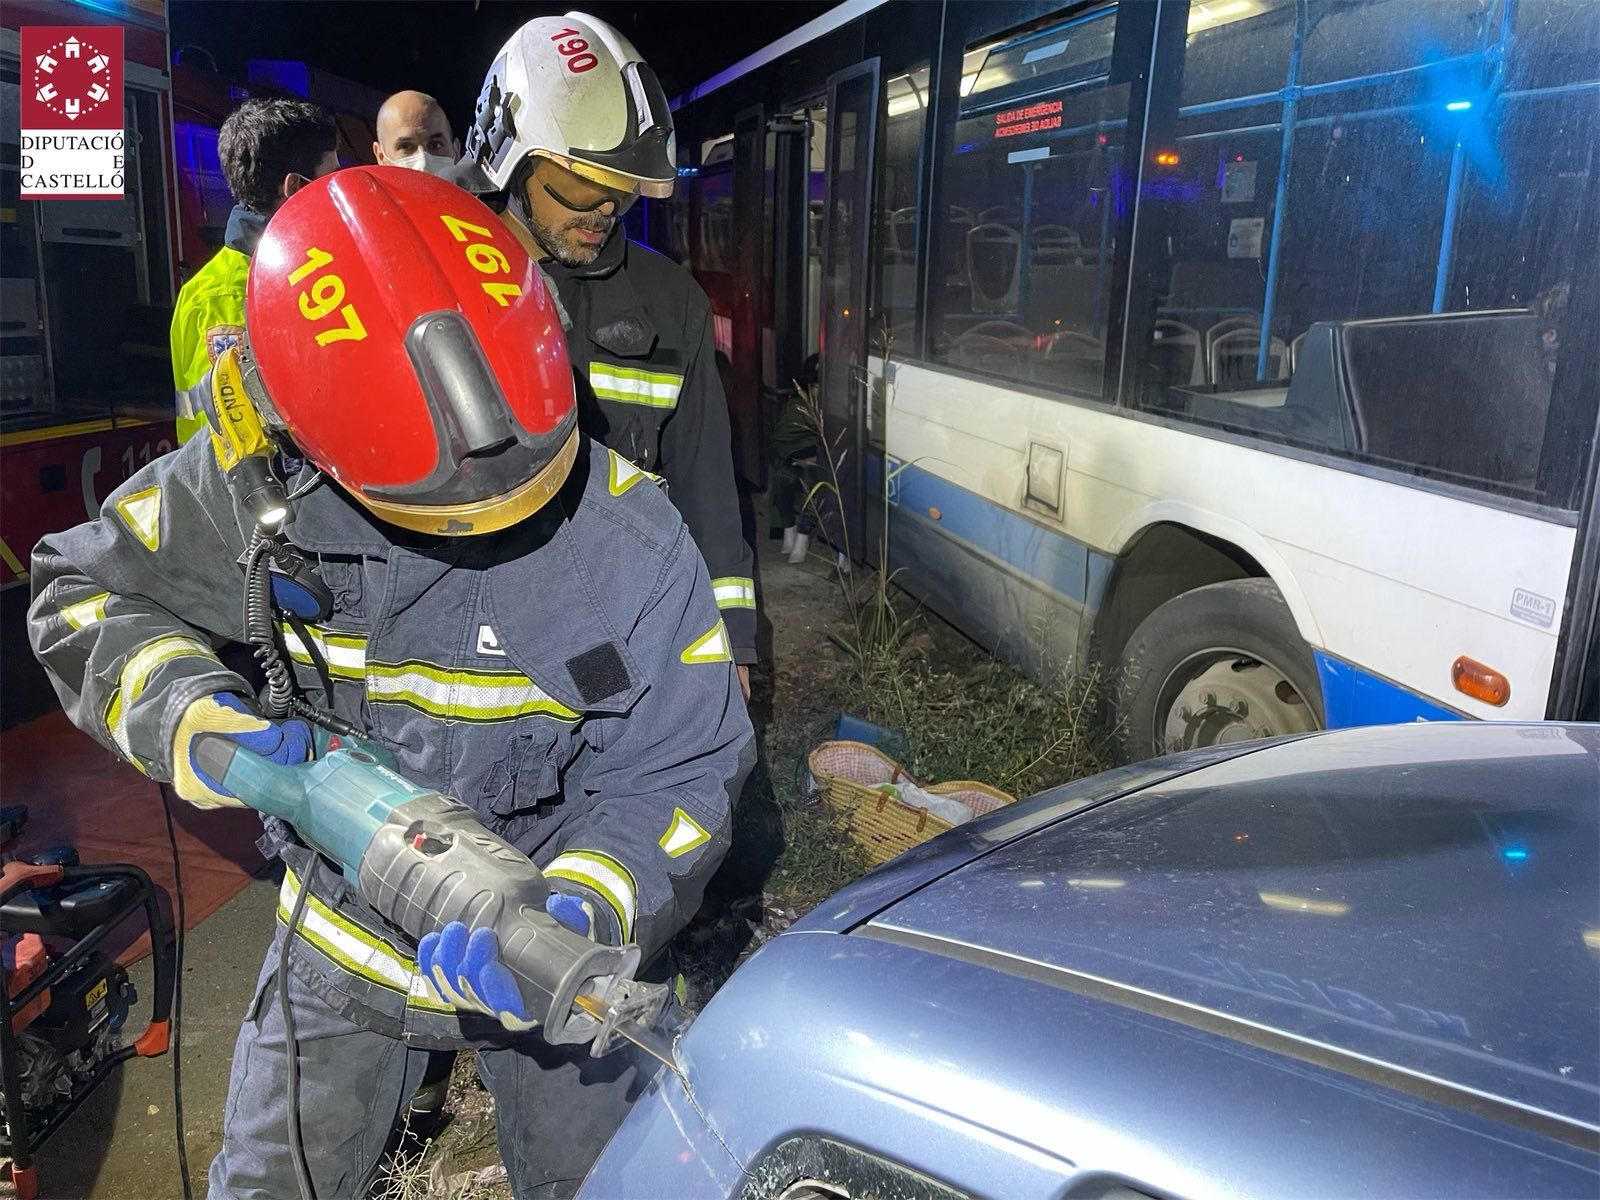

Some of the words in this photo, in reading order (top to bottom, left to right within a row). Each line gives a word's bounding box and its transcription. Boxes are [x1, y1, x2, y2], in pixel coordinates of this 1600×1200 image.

[551, 28, 599, 74] 190
[287, 246, 368, 347] 197
[440, 215, 523, 307] 197
